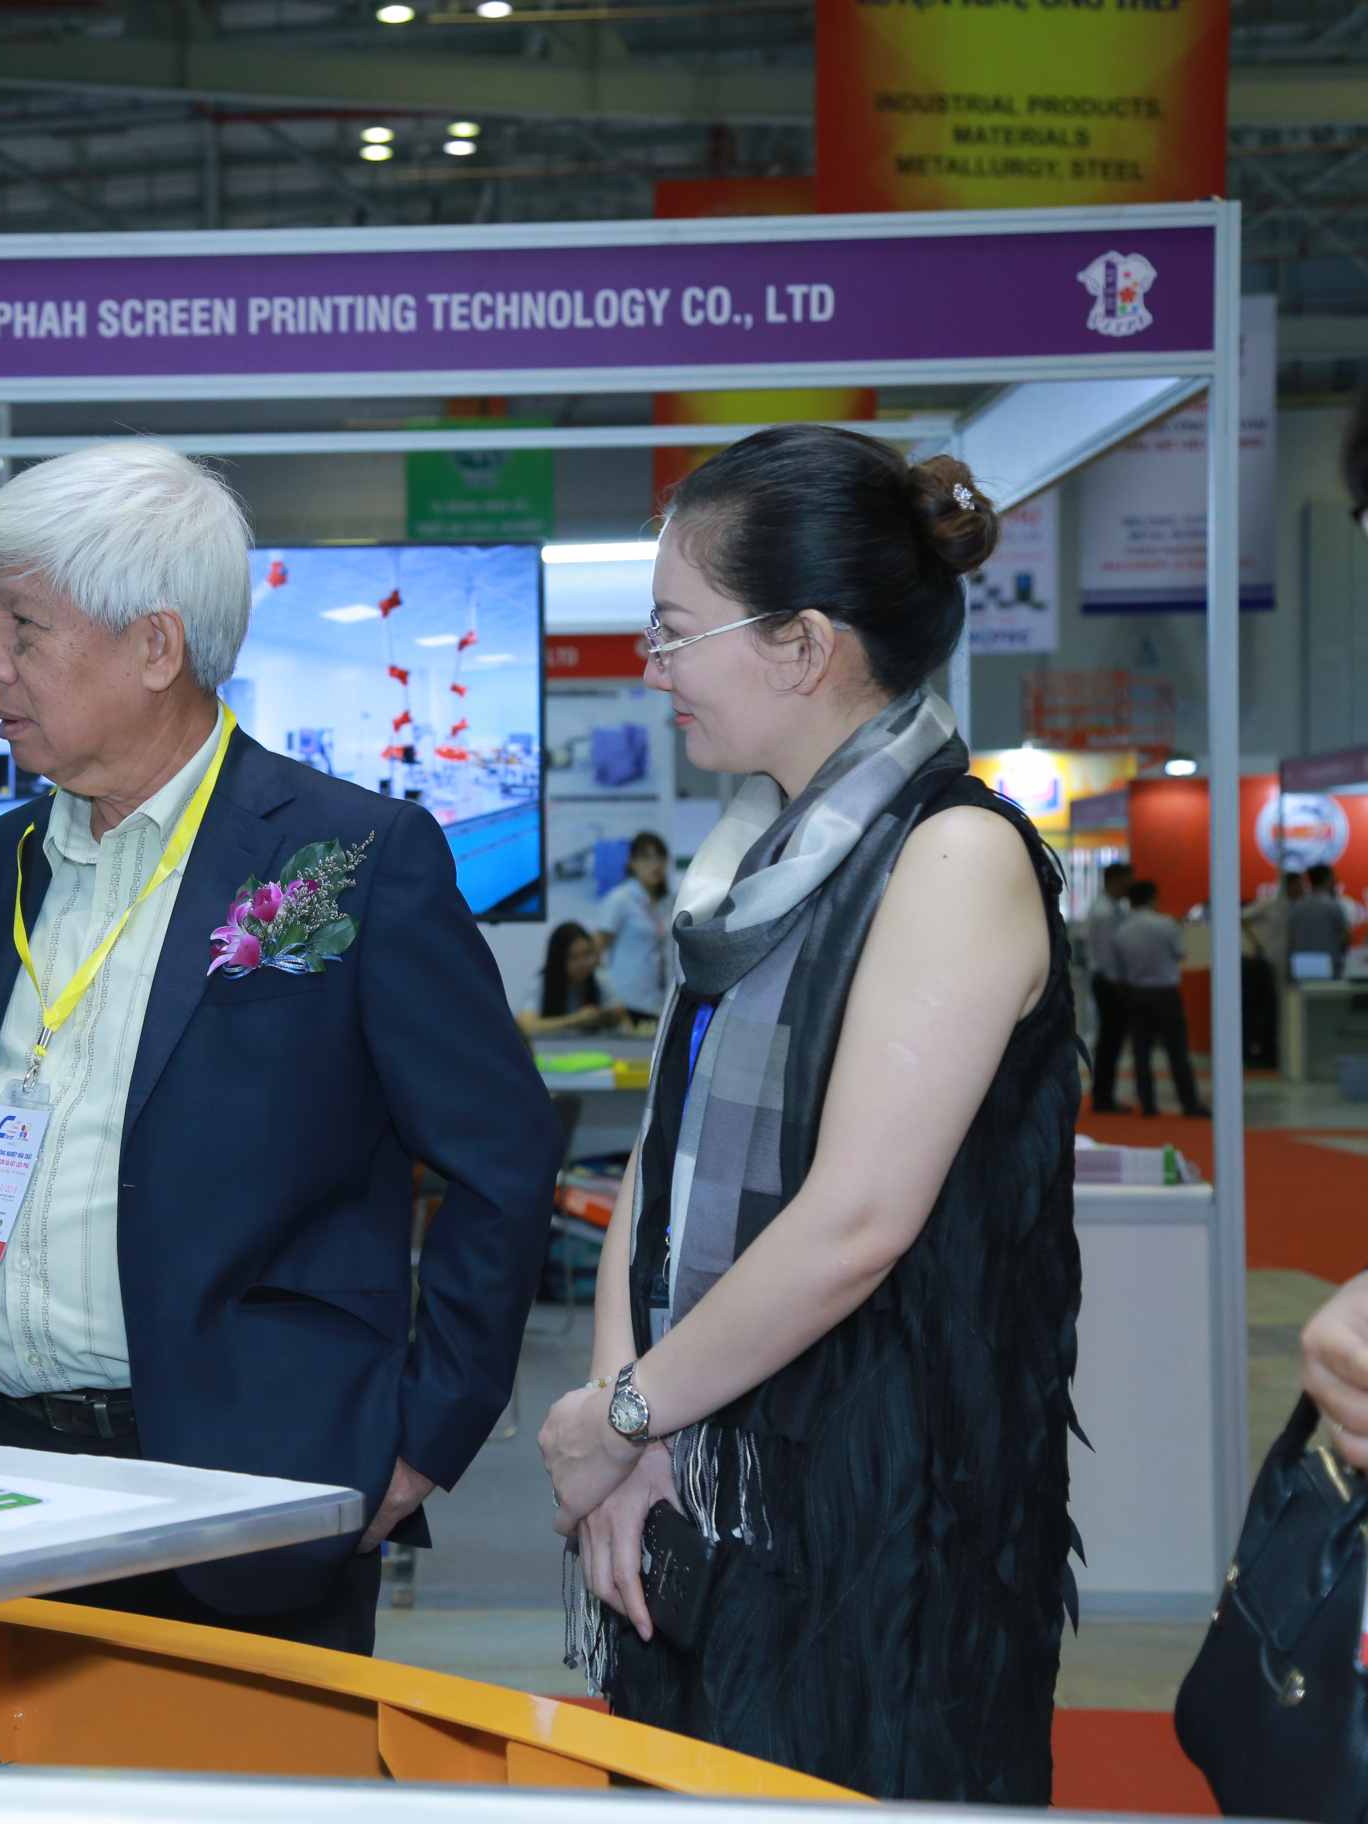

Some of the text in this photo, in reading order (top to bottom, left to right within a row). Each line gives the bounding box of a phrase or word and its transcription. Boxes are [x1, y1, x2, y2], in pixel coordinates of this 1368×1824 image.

[874, 92, 1016, 116] INDUSTRIAL
[952, 125, 1090, 148] MATERIALS
[1071, 158, 1144, 182] STEEL
[98, 298, 236, 338] SCREEN
[248, 294, 417, 335] PRINTING
[427, 288, 670, 331] TECHNOLOGY
[682, 286, 754, 329] CO.,
[766, 284, 835, 324] LTD
